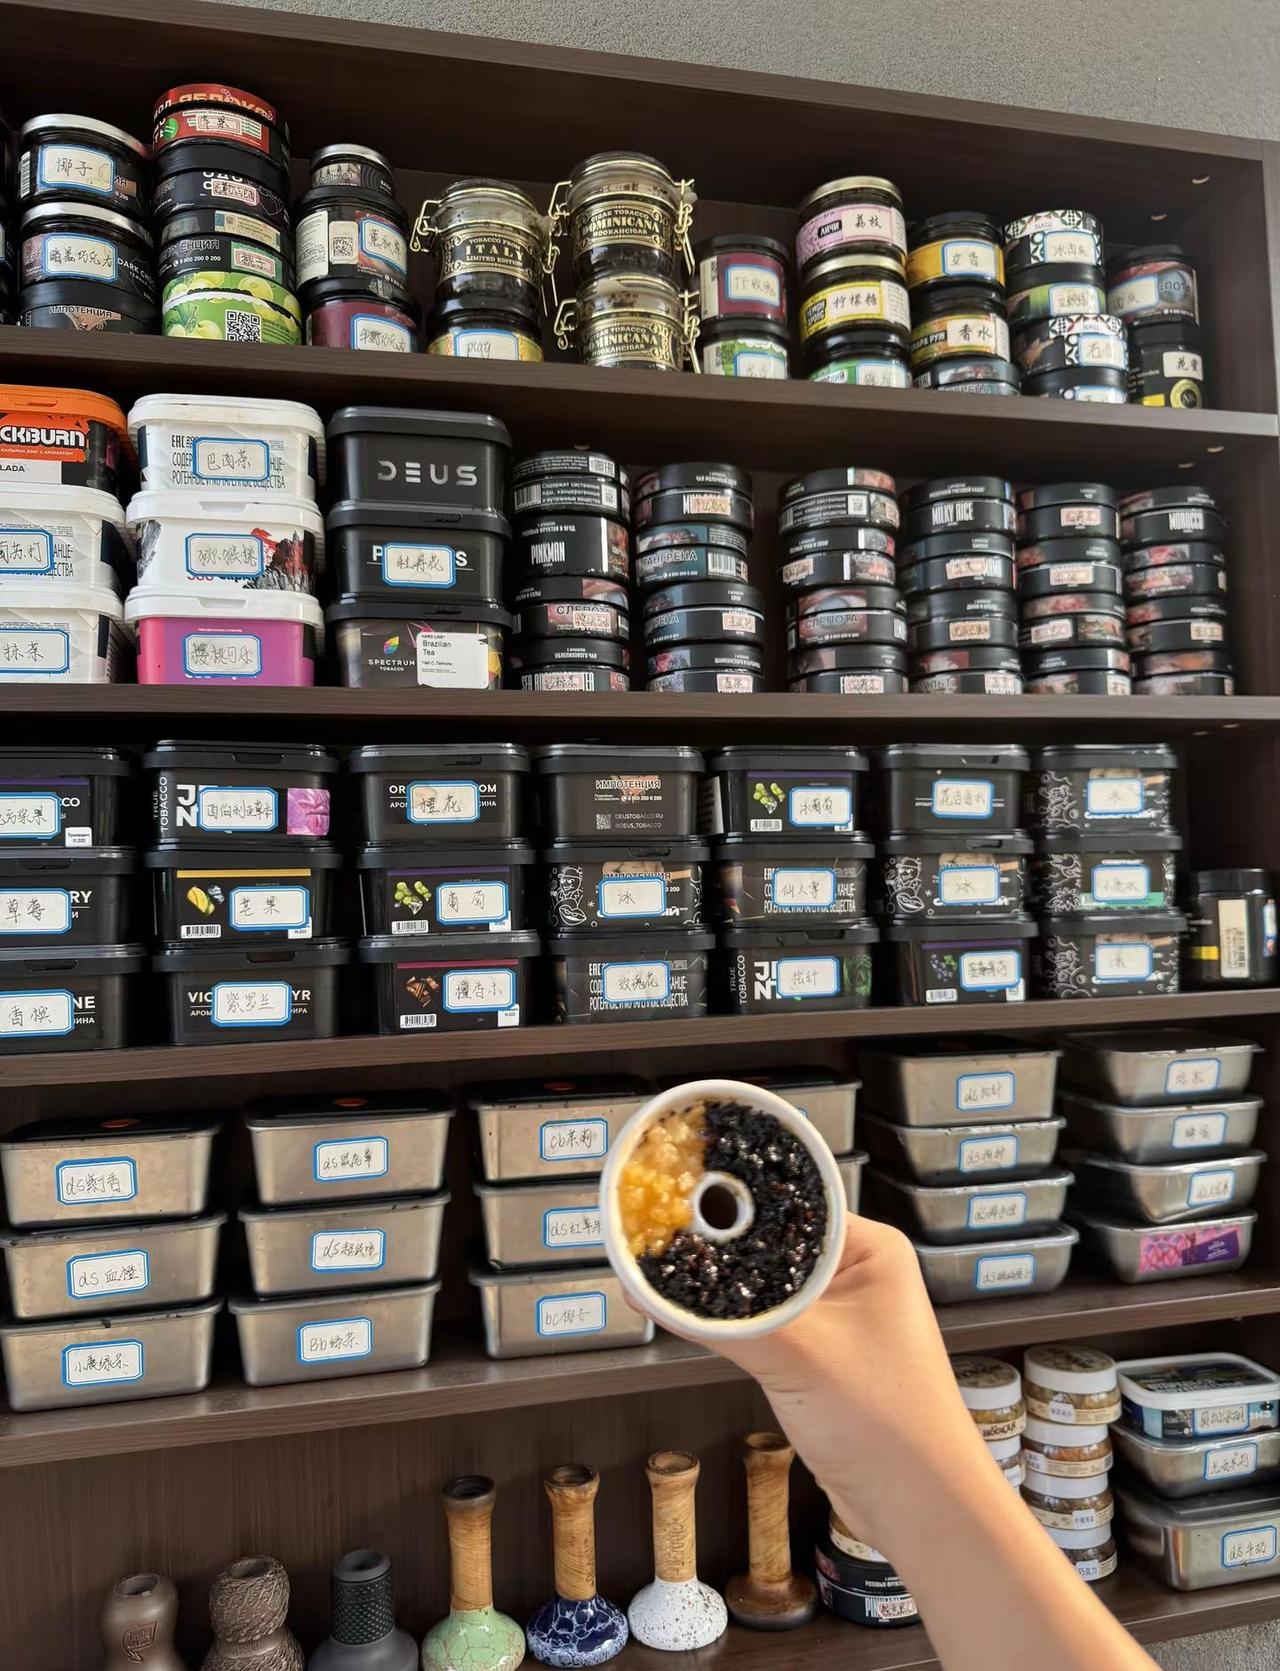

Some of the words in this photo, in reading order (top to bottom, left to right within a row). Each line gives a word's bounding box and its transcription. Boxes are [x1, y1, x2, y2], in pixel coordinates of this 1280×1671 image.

[613, 209, 650, 220] TOBACCO
[582, 216, 660, 235] DOMINICANA
[464, 244, 524, 260] ITALY
[377, 460, 478, 487] DEUS
[931, 503, 955, 526] MILKY
[955, 502, 974, 521] RICE
[530, 541, 566, 566] PINKMAN
[422, 639, 452, 649] Brazilian
[422, 648, 436, 656] Tea
[367, 658, 416, 666] SPECTRUM
[595, 779, 662, 790] ИМПОТЕНЦИЯ
[160, 776, 169, 833] TOBACCO
[739, 954, 747, 1005] TOBACCO
